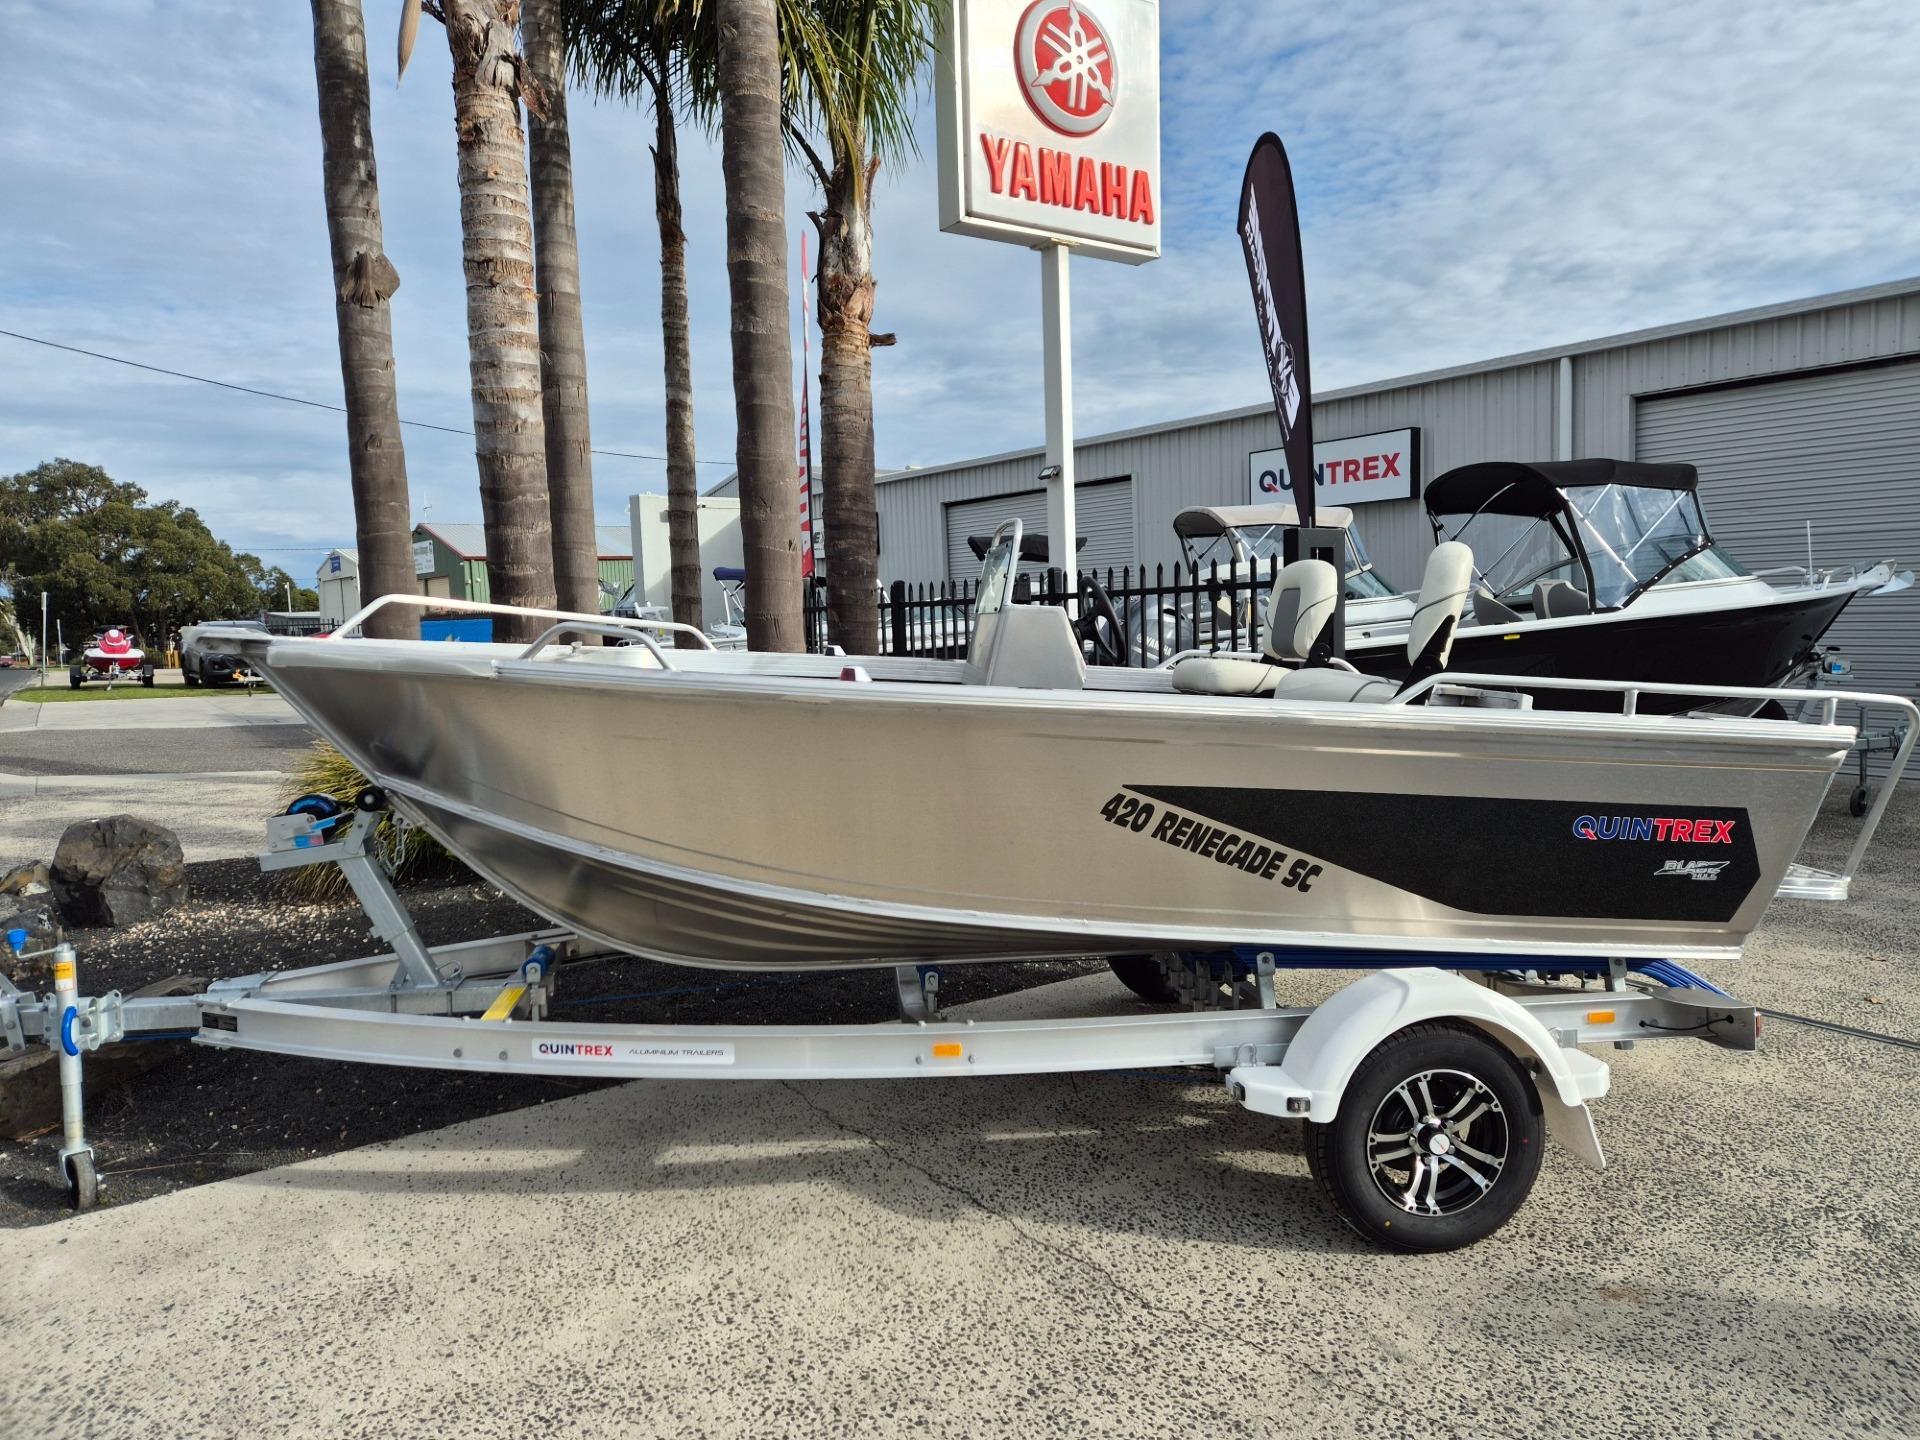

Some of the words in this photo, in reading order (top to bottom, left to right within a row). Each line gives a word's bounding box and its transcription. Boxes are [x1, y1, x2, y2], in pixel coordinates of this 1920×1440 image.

[979, 133, 1155, 225] YAMAHA
[1259, 452, 1401, 493] QUNTREX
[1146, 636, 1172, 657] YAMHA
[1100, 793, 1155, 833] 420
[1151, 811, 1288, 880] RENEGADE
[1281, 859, 1323, 893] SC
[1572, 815, 1736, 844] QUINTREX
[538, 1043, 613, 1056] QUINTREX
